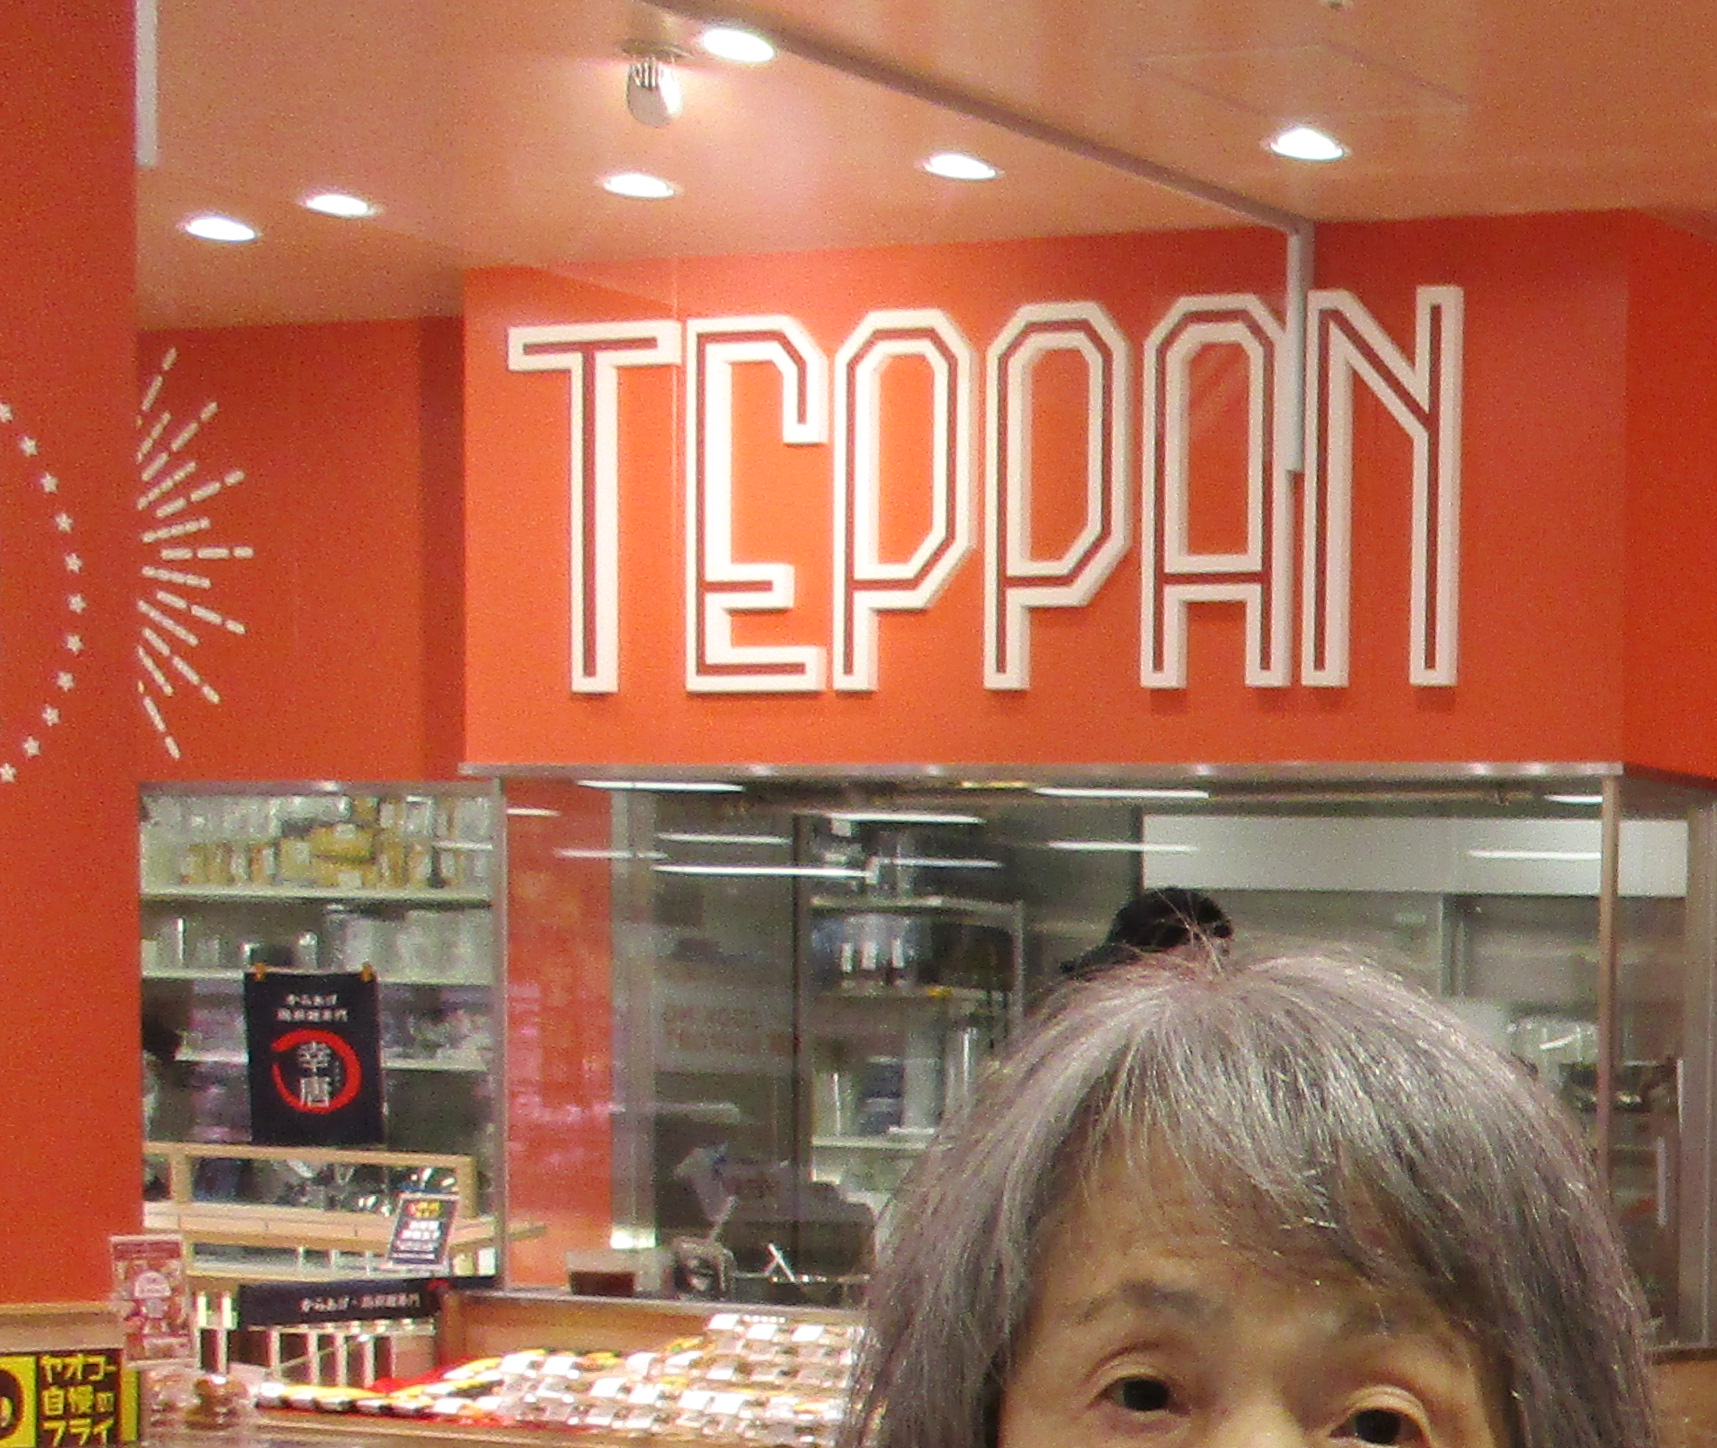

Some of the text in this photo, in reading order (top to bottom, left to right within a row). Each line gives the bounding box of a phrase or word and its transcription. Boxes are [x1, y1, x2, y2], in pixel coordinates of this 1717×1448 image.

[506, 285, 1464, 694] TEPPAN
[40, 1353, 118, 1384] ヤオコー
[42, 1417, 115, 1448] フライ
